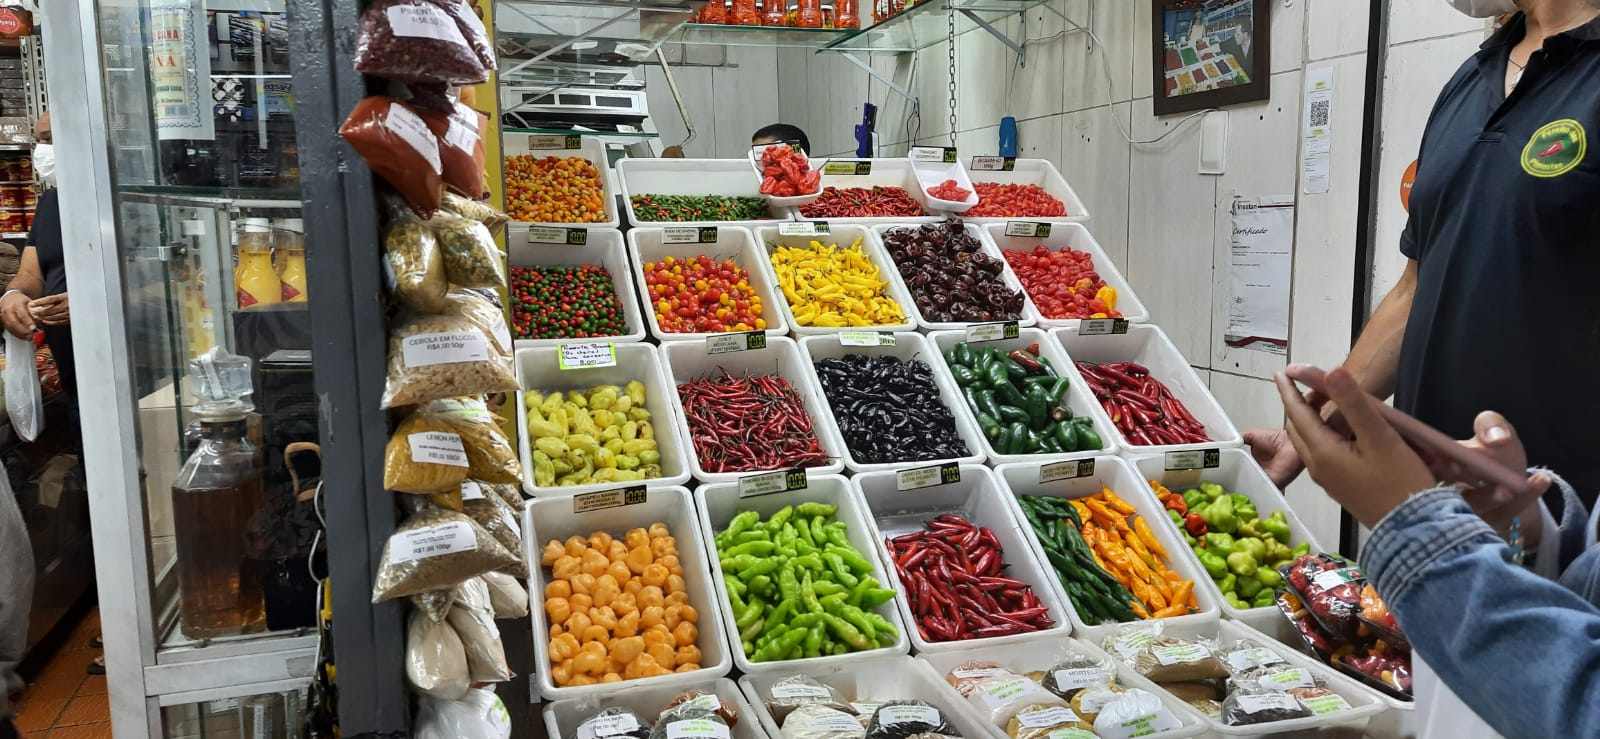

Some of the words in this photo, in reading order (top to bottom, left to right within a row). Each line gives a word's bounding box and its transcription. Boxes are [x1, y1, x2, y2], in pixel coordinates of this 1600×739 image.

[1232, 227, 1269, 237] Certificado
[409, 335, 438, 346] CEBOLA
[426, 434, 448, 442] LEMON
